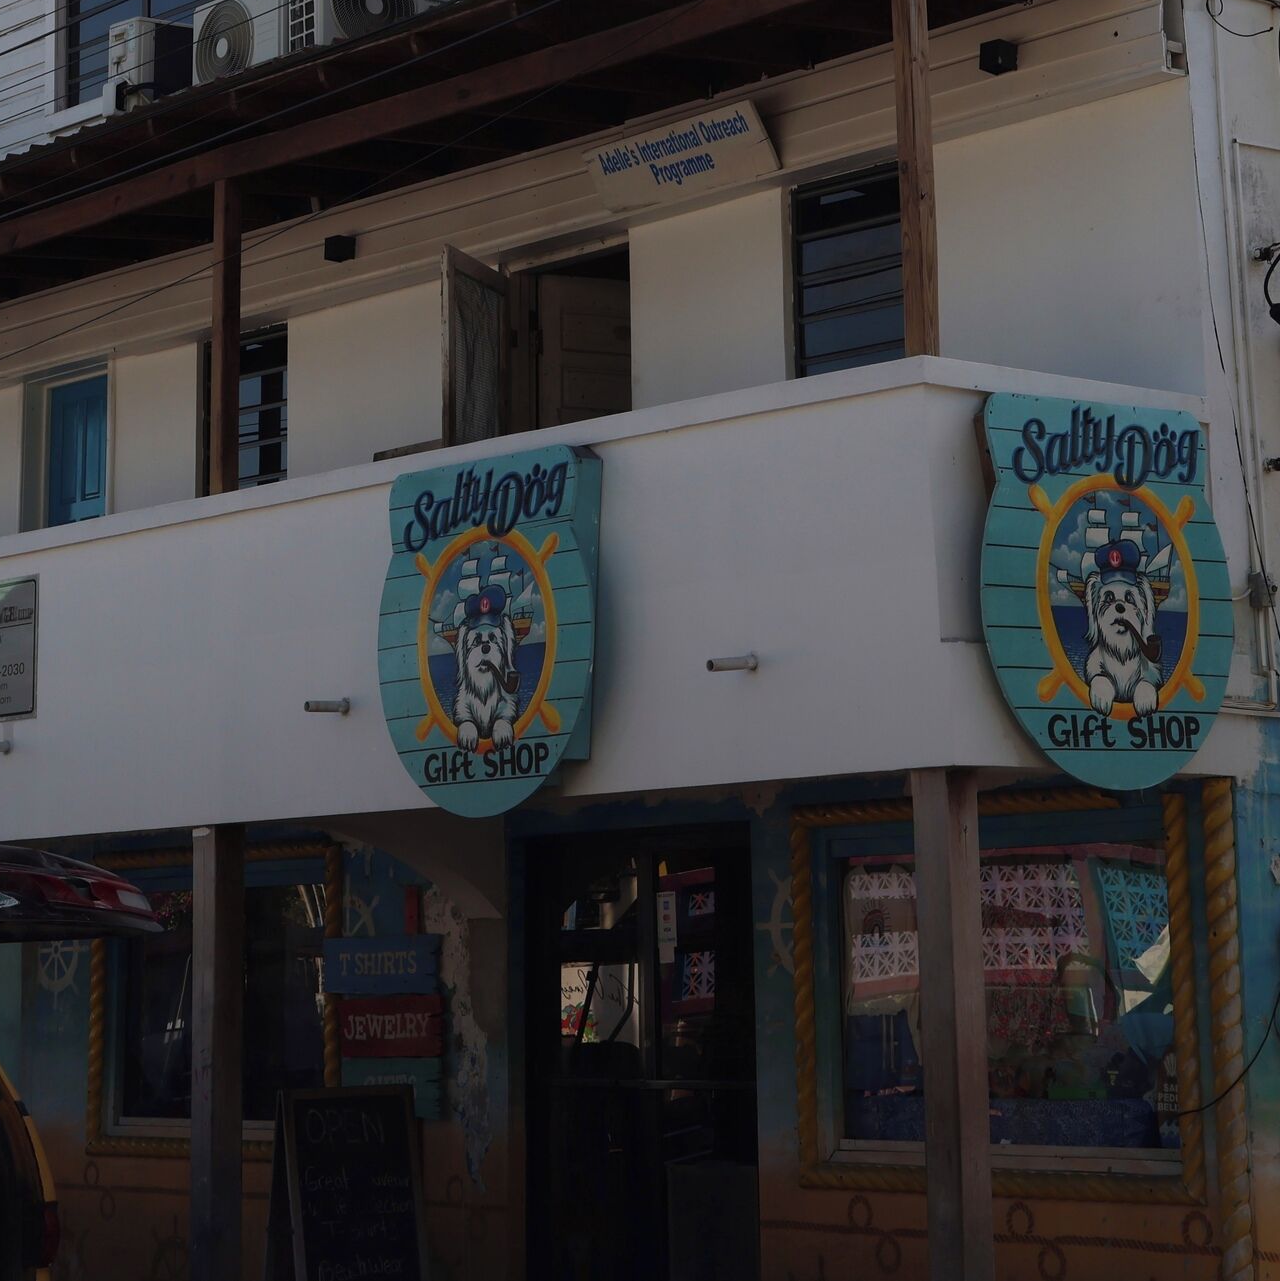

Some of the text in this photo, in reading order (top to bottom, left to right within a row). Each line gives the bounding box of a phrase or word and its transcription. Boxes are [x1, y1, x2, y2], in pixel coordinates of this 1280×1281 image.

[598, 110, 749, 175] Adelle's International Outreach
[650, 152, 715, 185] Programme
[1012, 404, 1115, 485] Salty
[404, 464, 494, 553] Salty
[1127, 715, 1200, 749] SHOP
[483, 741, 550, 778] SHOP
[339, 950, 417, 977] T SHIRTS
[343, 1012, 431, 1041] JEWELRY
[305, 1108, 386, 1145] OPEN
